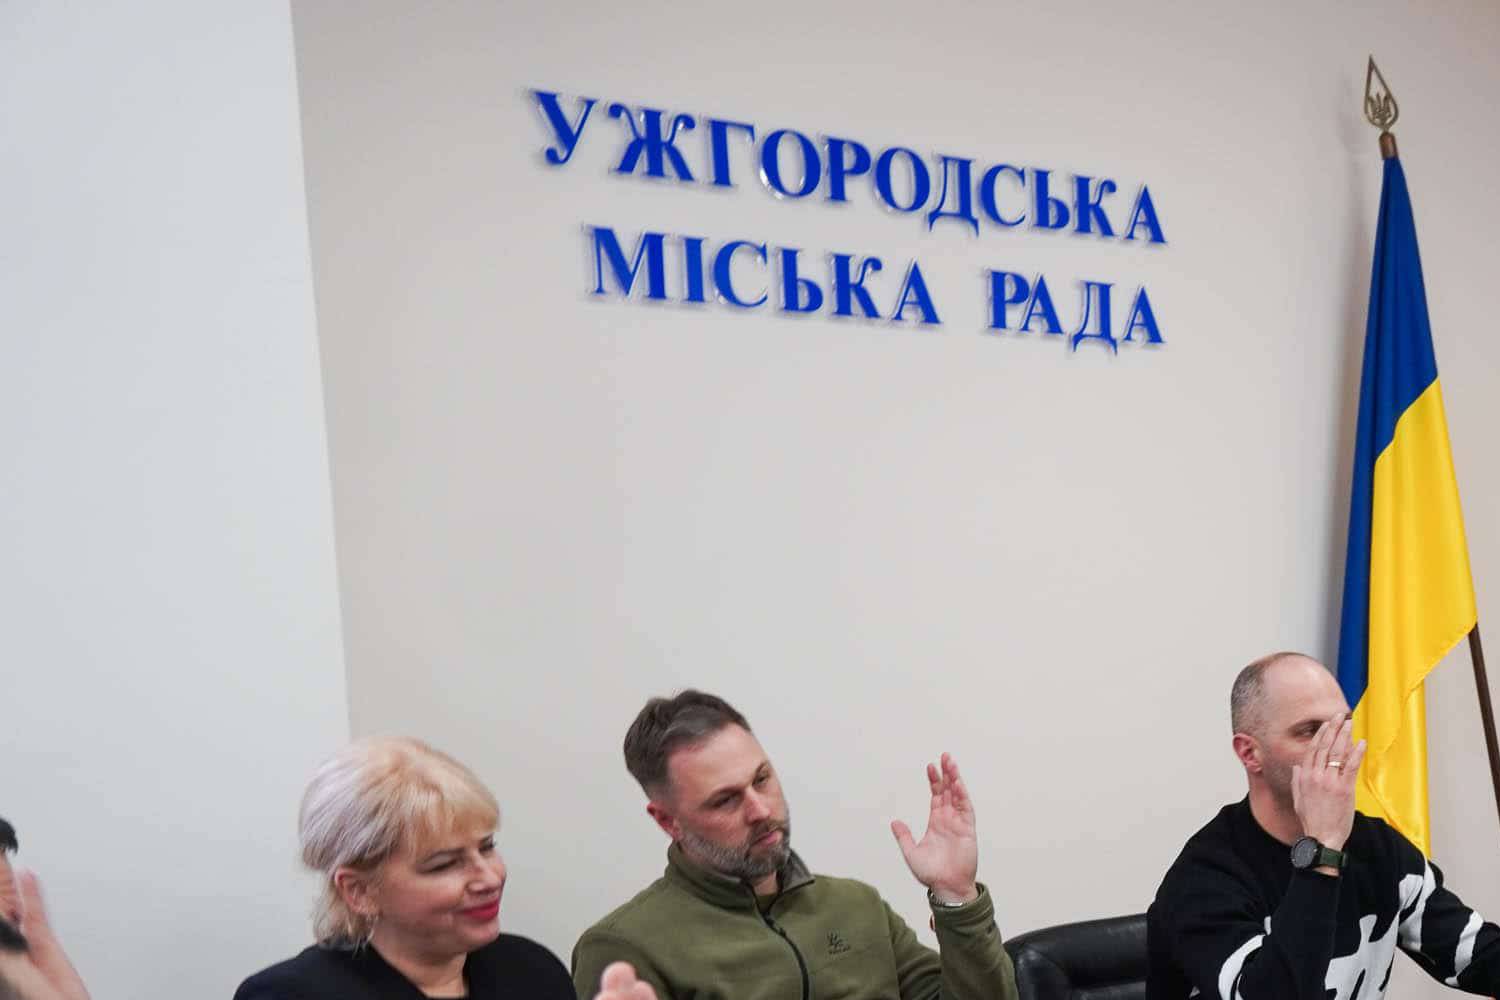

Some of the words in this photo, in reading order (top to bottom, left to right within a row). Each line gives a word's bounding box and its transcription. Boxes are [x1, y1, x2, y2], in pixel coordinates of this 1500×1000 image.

[532, 89, 1168, 245] УЖГОРОДСЬКА
[588, 225, 943, 325] МІСЬКА
[987, 269, 1165, 353] РАДА
